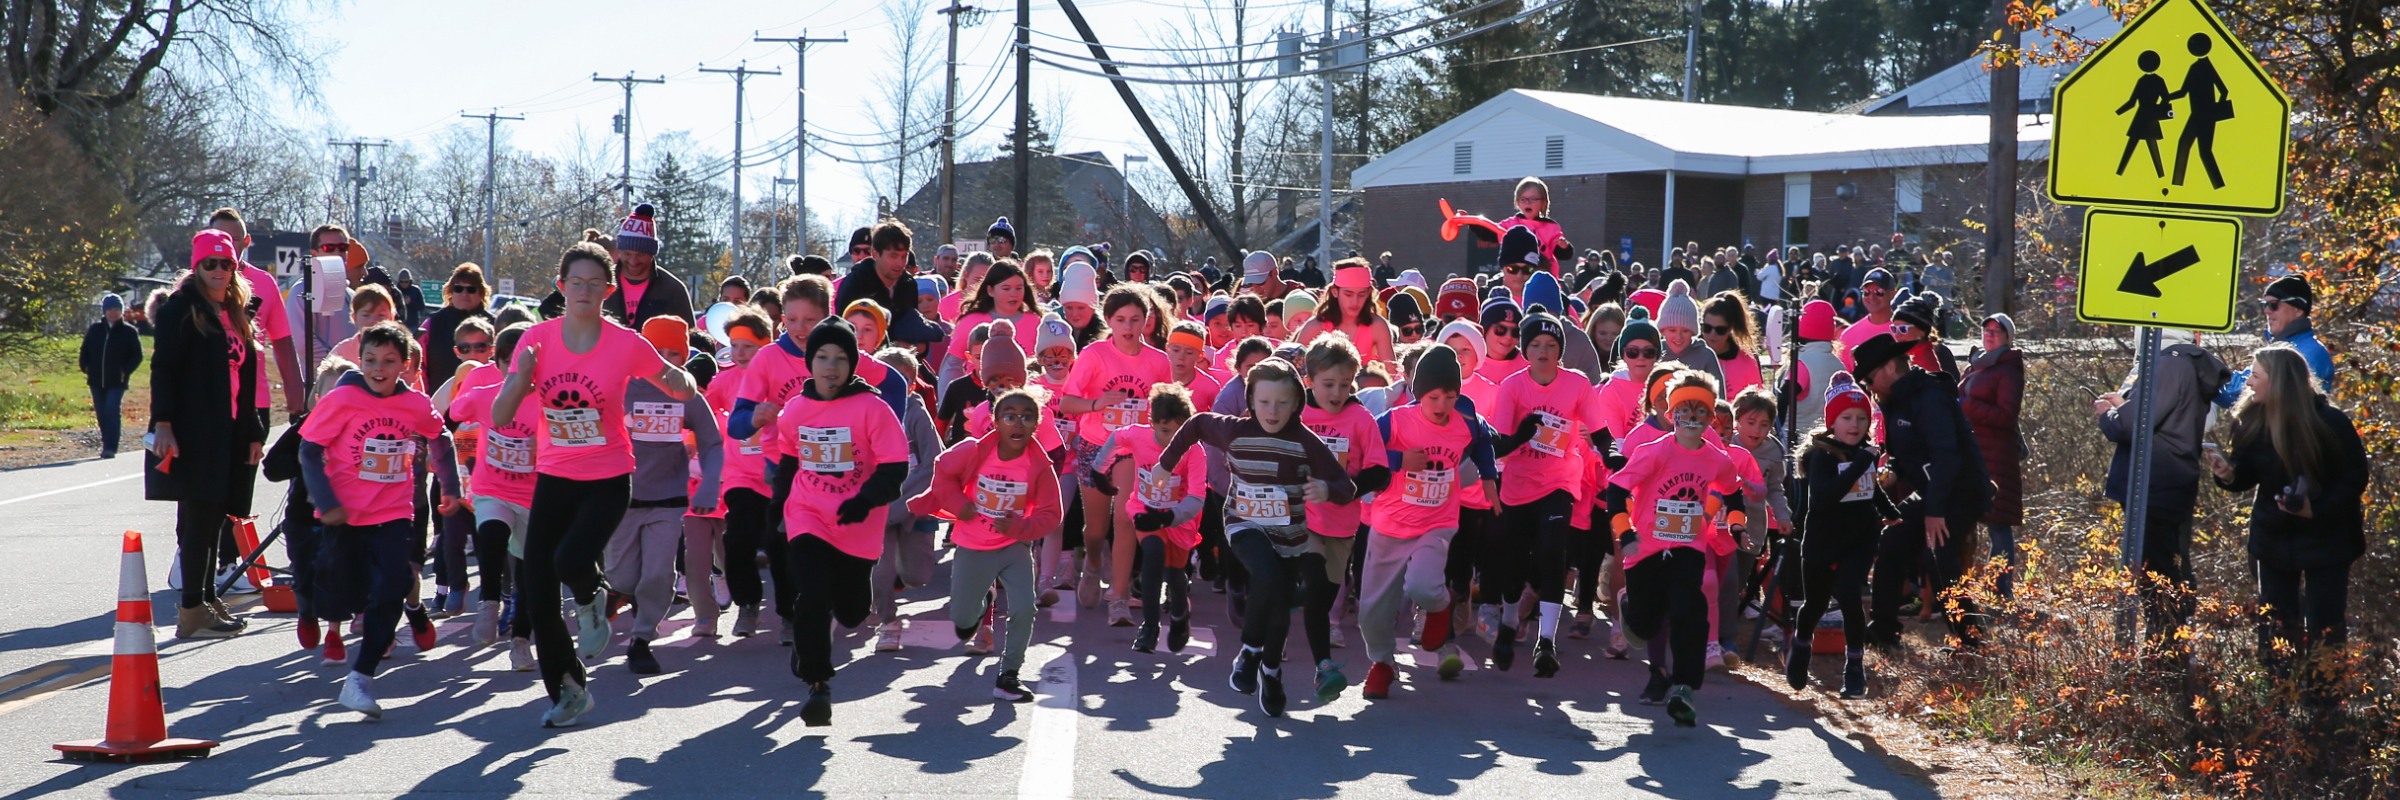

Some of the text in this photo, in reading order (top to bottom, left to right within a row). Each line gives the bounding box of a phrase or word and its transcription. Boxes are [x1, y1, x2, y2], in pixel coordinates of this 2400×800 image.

[962, 243, 978, 252] JCT
[353, 417, 394, 442] HAMPTON
[563, 421, 599, 439] 133
[648, 416, 681, 434] 258
[1549, 430, 1561, 447] 2
[501, 448, 530, 466] 129
[819, 444, 841, 463] 37
[387, 455, 404, 474] 14
[1421, 482, 1450, 499] 109
[1657, 472, 1695, 497] HAMPTON
[996, 494, 1016, 511] 72
[1151, 486, 1172, 502] 53
[1249, 500, 1286, 517] 256
[1681, 516, 1692, 534] 3
